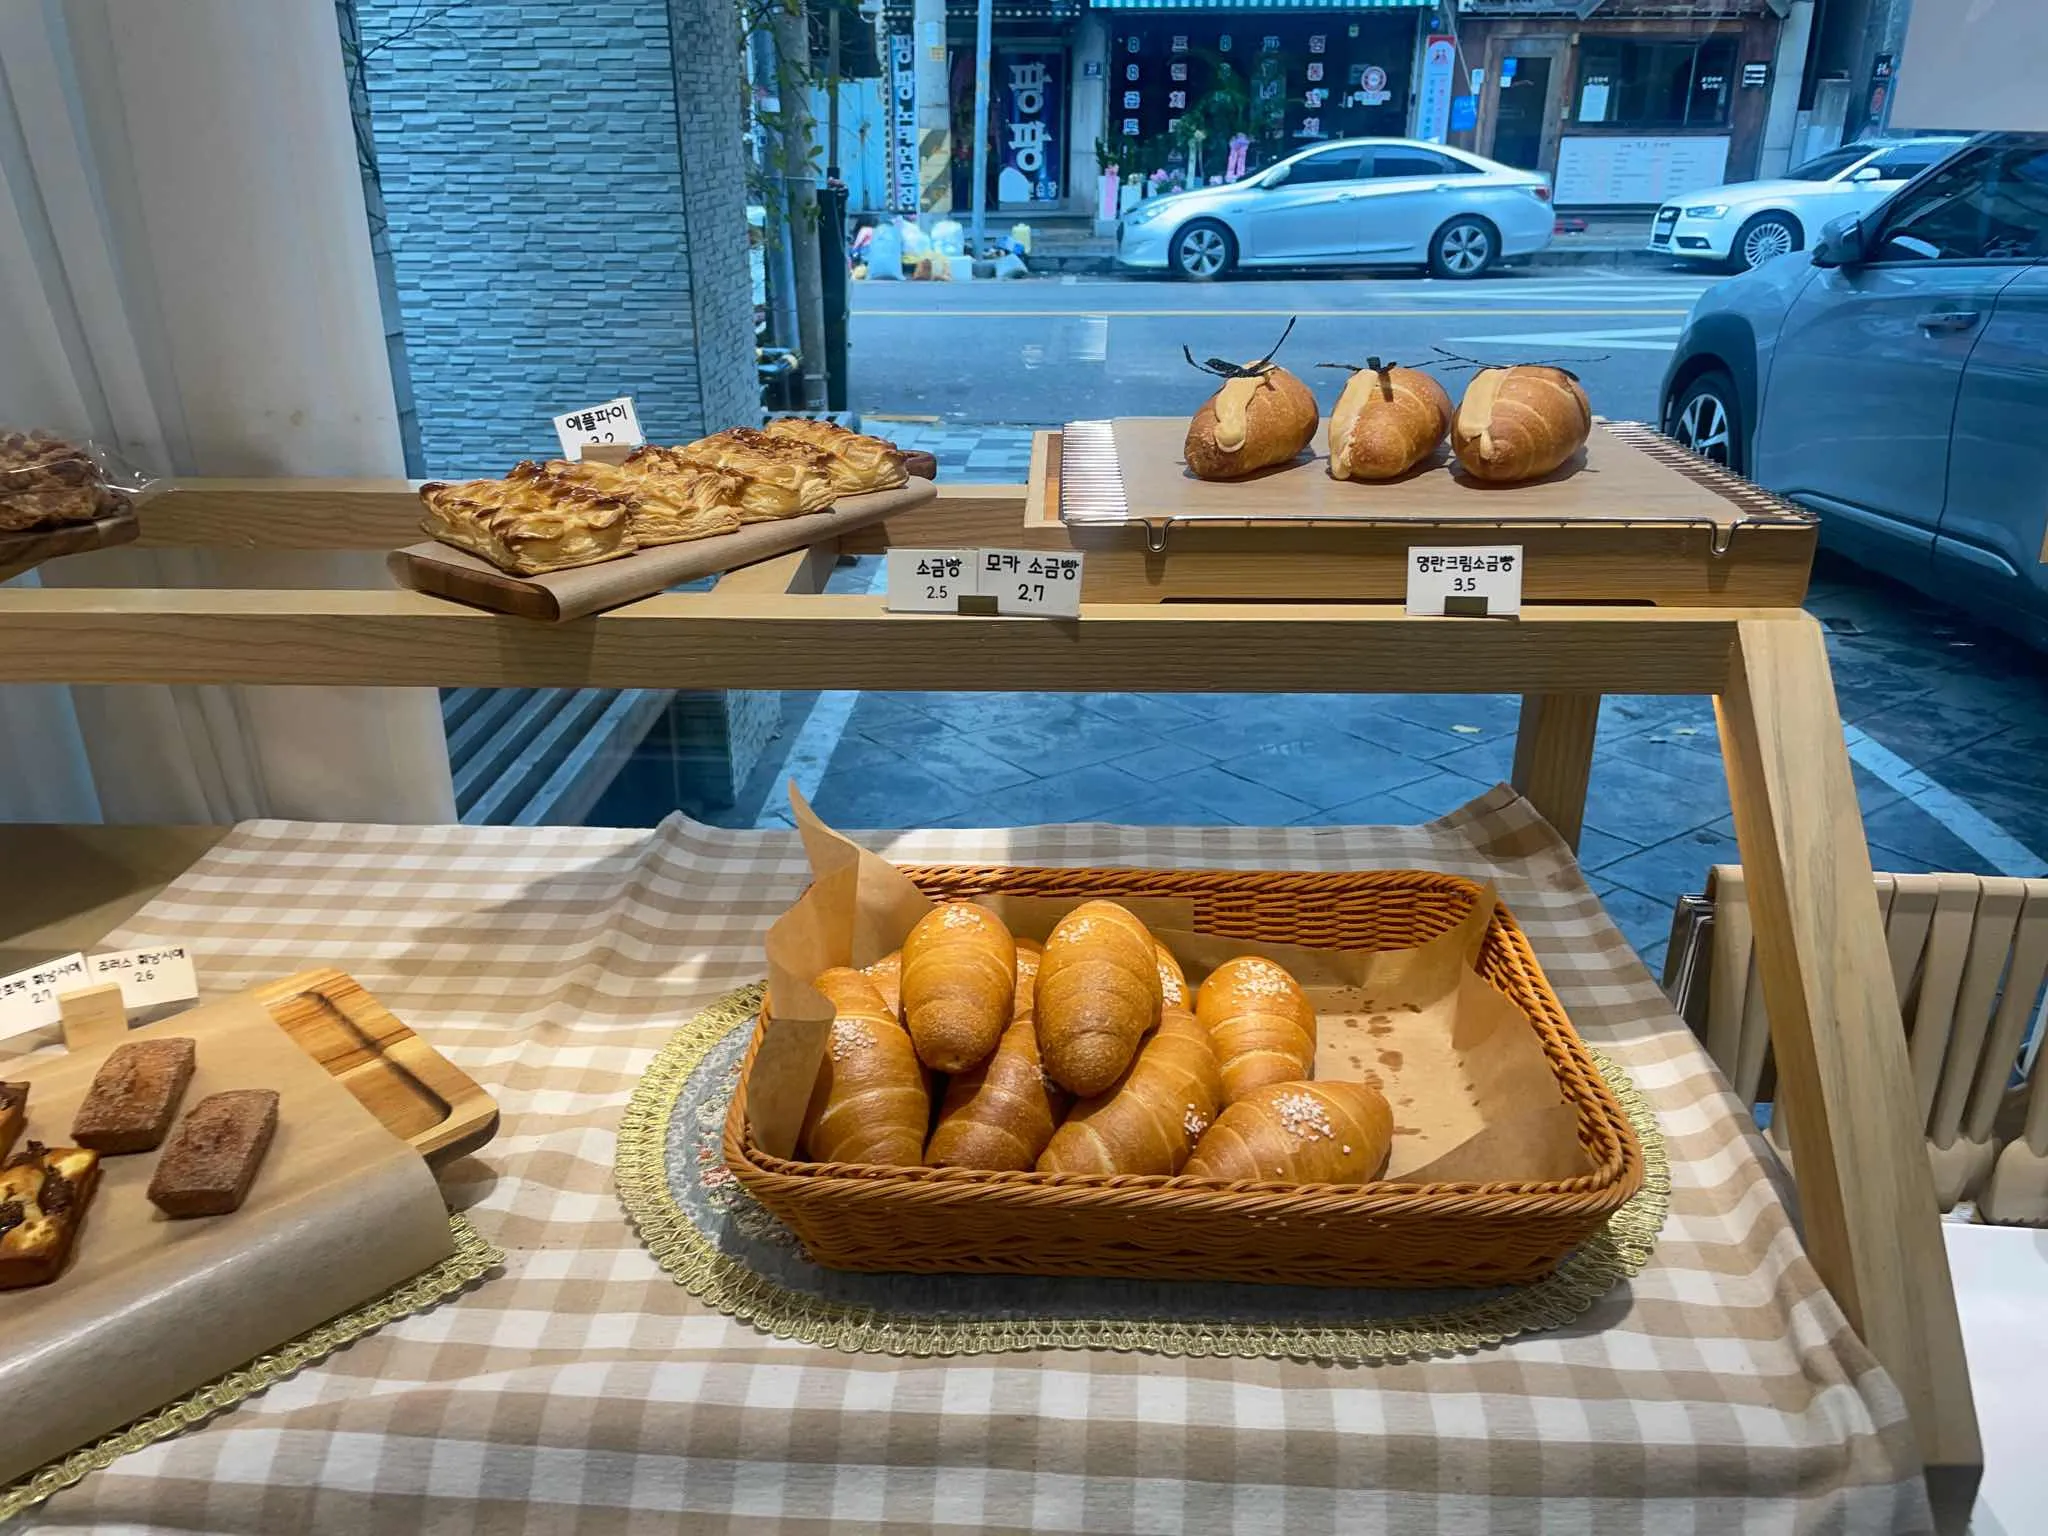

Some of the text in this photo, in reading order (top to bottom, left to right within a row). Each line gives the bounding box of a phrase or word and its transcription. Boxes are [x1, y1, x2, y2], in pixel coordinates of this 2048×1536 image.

[565, 404, 628, 431] 애플파이
[916, 558, 962, 578] 소금빵
[985, 554, 1079, 580] 모카 소금빵
[1416, 555, 1515, 573] 명란크림소금빵
[926, 585, 948, 599] 2.5
[1017, 584, 1044, 602] 2.7
[1453, 577, 1476, 592] 3.5
[0, 981, 27, 1000] 호박
